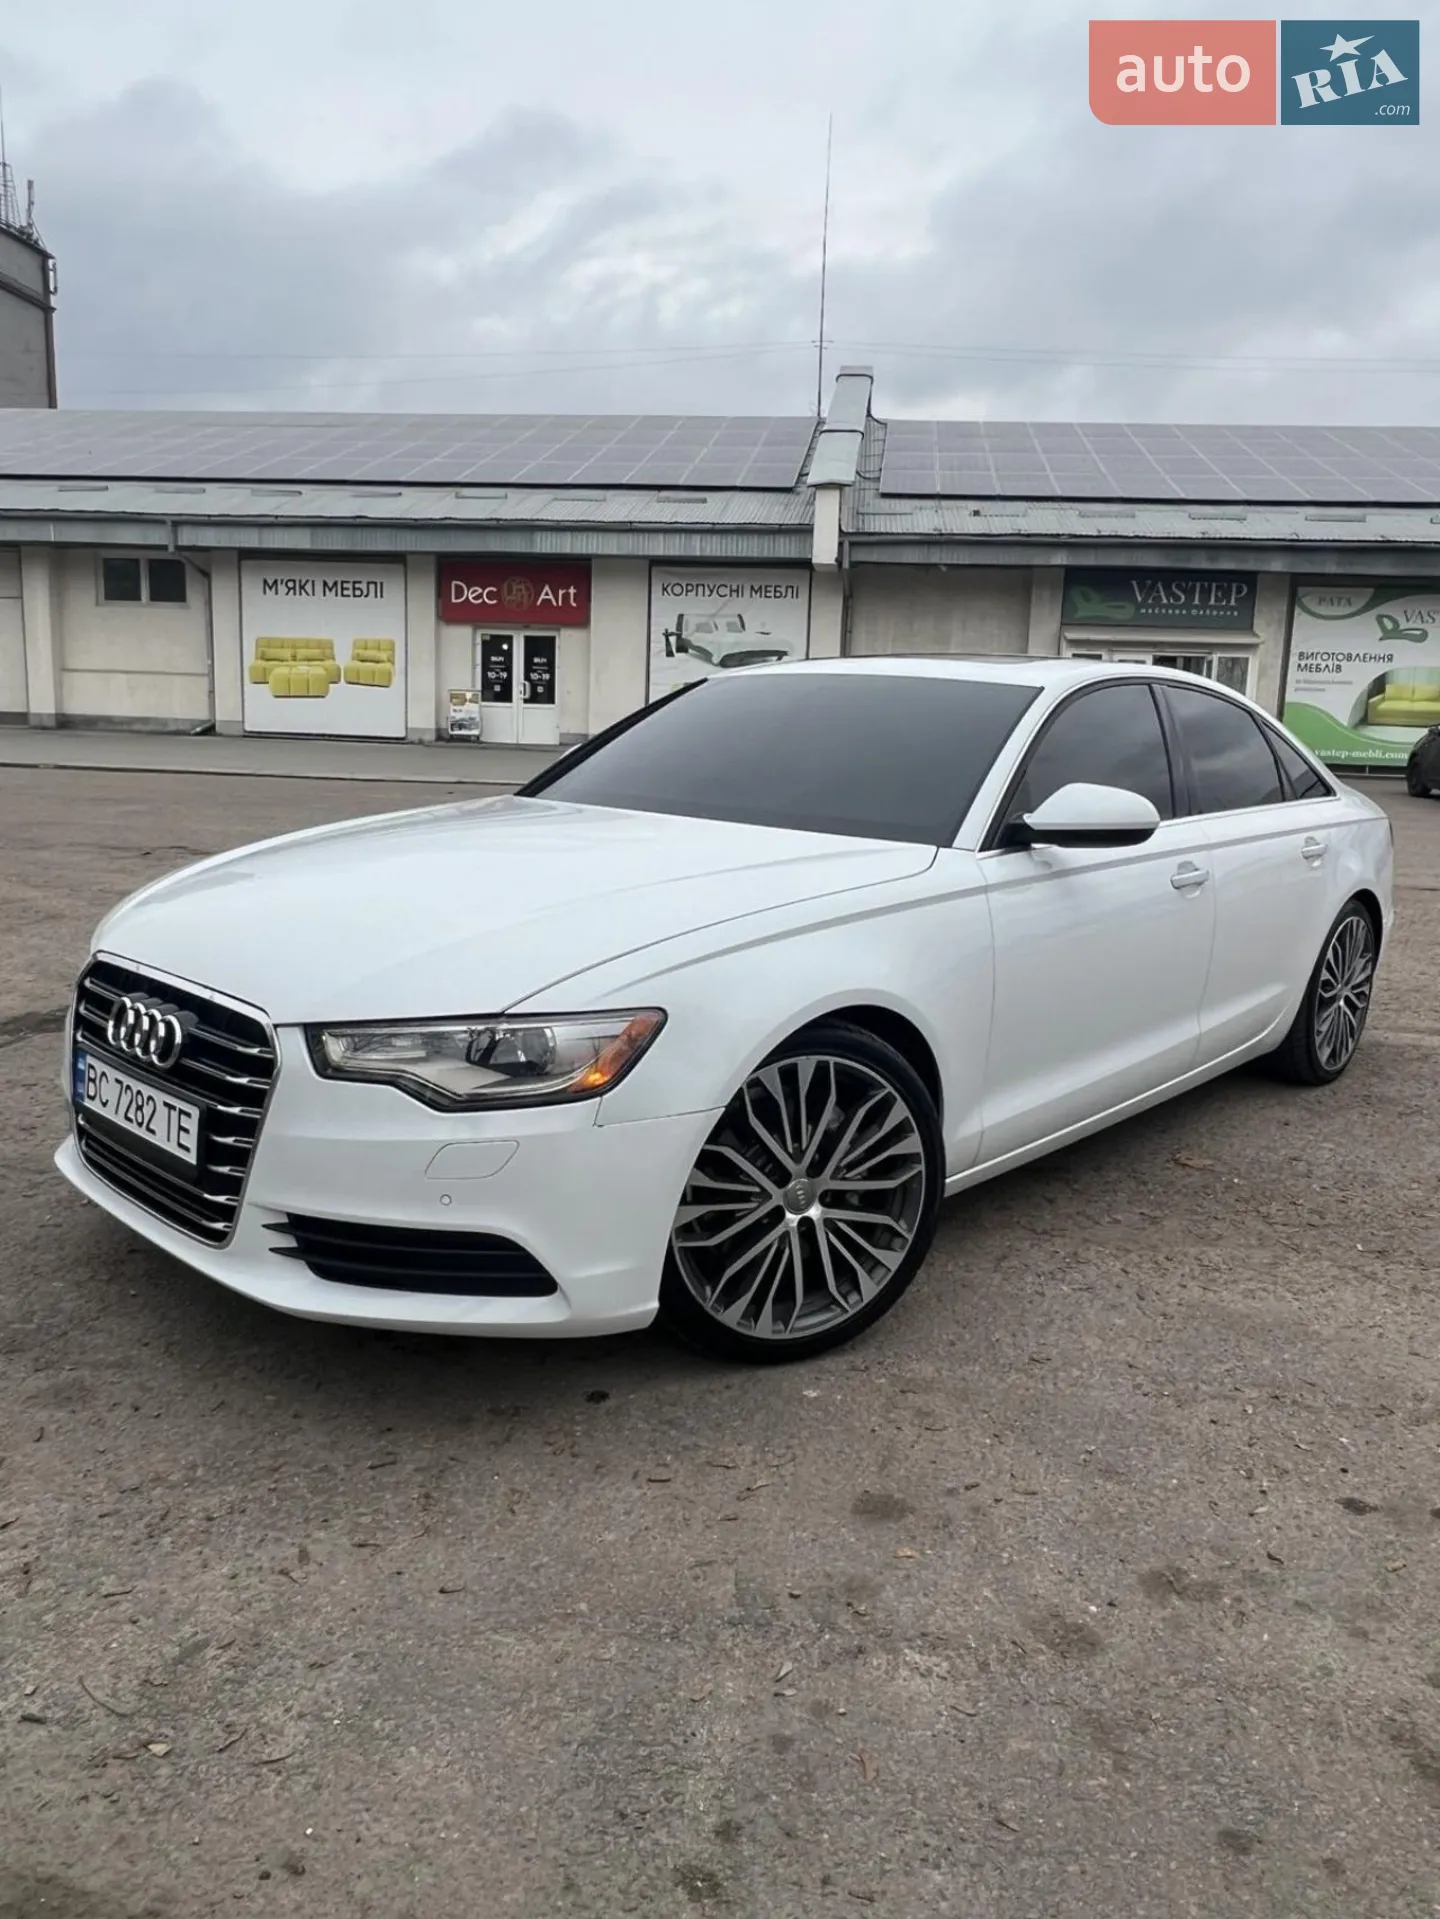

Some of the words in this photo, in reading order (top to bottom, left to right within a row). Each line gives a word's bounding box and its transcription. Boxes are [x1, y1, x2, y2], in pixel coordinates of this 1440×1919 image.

[262, 578, 316, 597] М'ЯКІ
[322, 579, 384, 599] МЕБЛІ
[450, 580, 498, 604] Dec
[536, 583, 577, 607] Art
[661, 582, 745, 599] КОРПУСНІ
[750, 584, 800, 600] МЕБЛІ
[1130, 579, 1248, 606] VASTEP
[1297, 651, 1395, 664] ВИГОТОВЛЕННЯ
[86, 1062, 110, 1108] BC
[114, 1077, 158, 1136] 7282
[163, 1100, 193, 1154] TE
